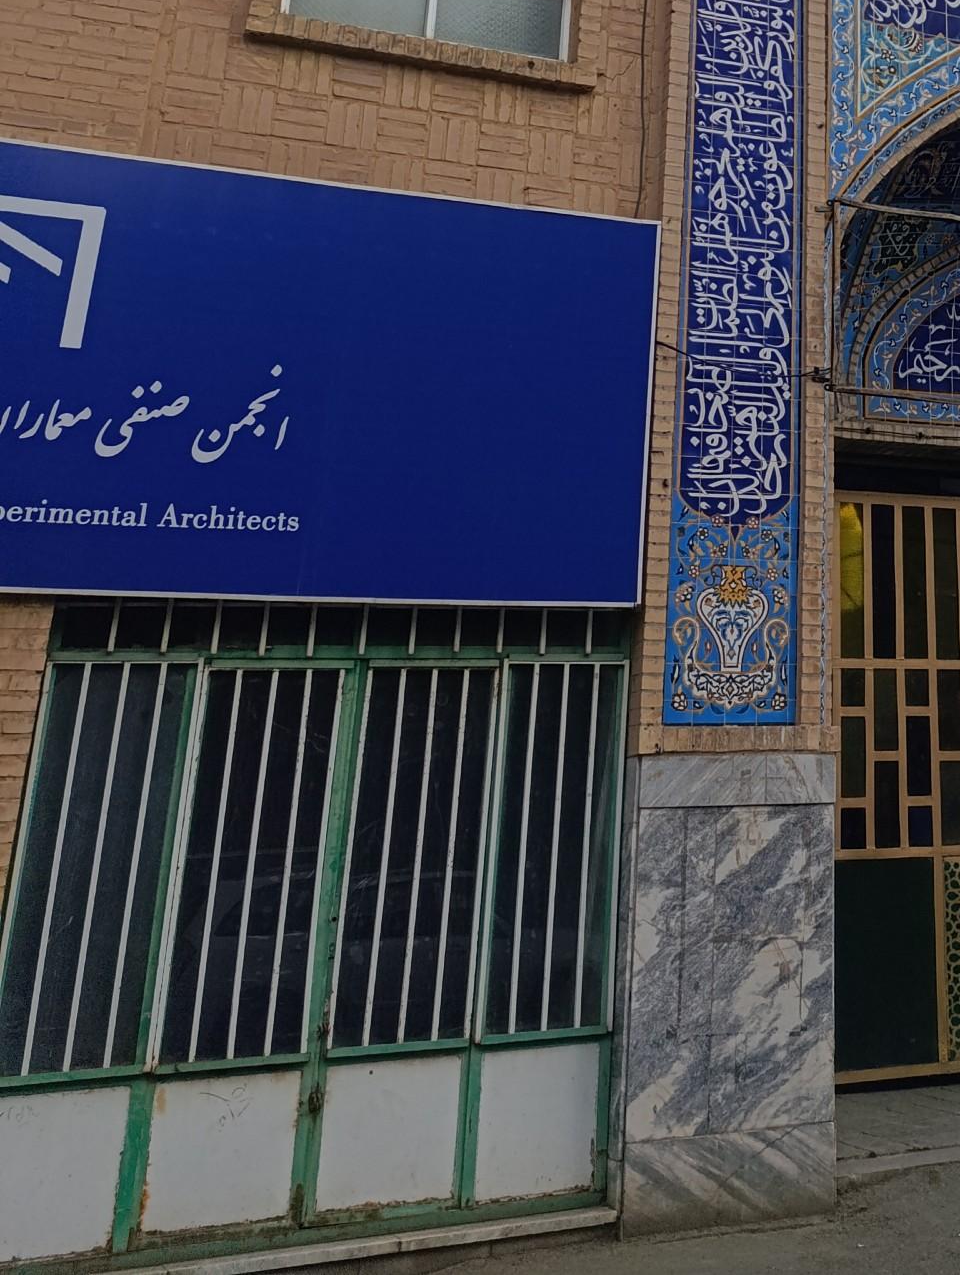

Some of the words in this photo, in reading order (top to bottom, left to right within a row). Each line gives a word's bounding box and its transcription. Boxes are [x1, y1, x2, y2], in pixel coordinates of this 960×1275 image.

[94, 380, 190, 458] صنفی
[191, 364, 289, 463] انجمن
[157, 502, 300, 532] Architects
